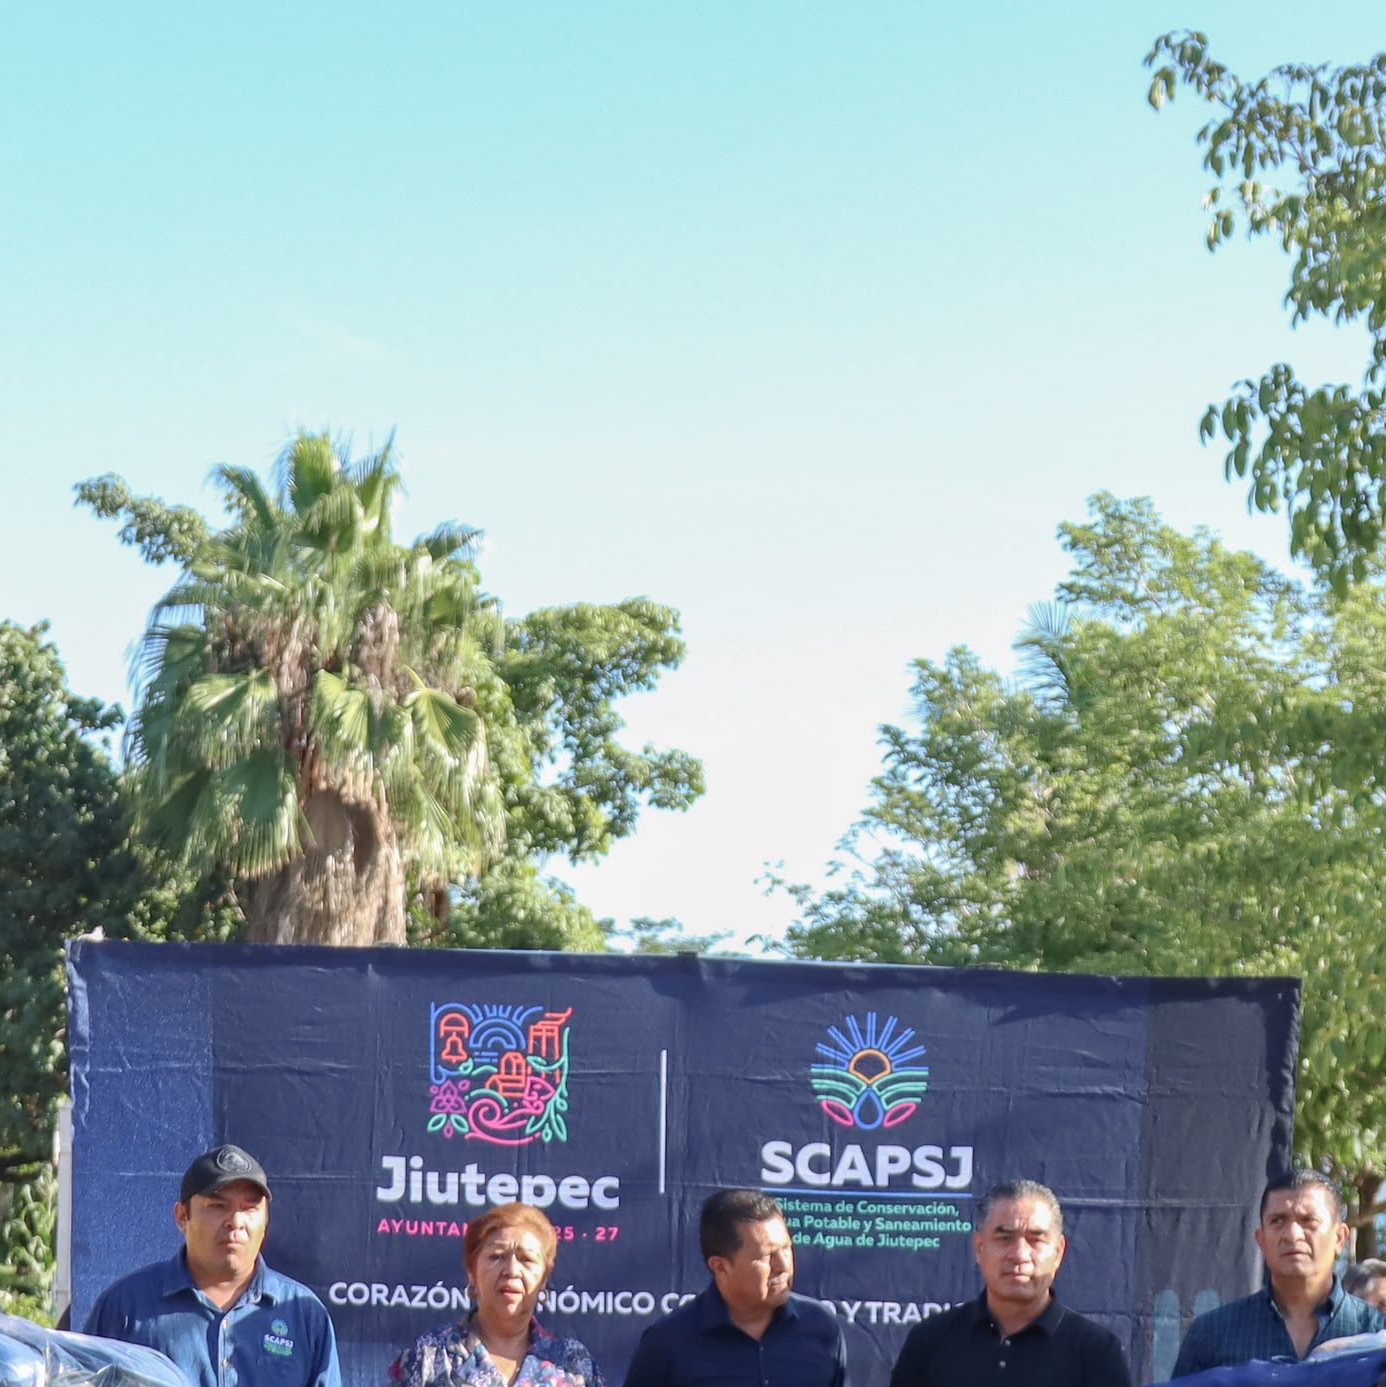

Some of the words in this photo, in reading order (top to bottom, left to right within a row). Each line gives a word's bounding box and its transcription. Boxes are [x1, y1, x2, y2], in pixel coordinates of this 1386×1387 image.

[761, 1140, 974, 1189] SCAPSJ
[376, 1155, 620, 1209] Jiutepec
[775, 1197, 832, 1213] Sistema
[835, 1200, 854, 1213] de
[857, 1200, 960, 1218] Conservación,
[377, 1218, 468, 1237] AYUNTA
[595, 1226, 619, 1241] 27
[804, 1214, 861, 1230] Potable
[863, 1219, 873, 1233] y
[875, 1217, 972, 1232] Saneamiento
[792, 1231, 811, 1245] de
[813, 1231, 853, 1249] Agua
[856, 1233, 875, 1246] de
[877, 1233, 941, 1251] Jiutepec
[328, 1281, 471, 1311] CORAZÓN
[536, 1285, 655, 1314] NÓMICO
[841, 1301, 862, 1324] Y
